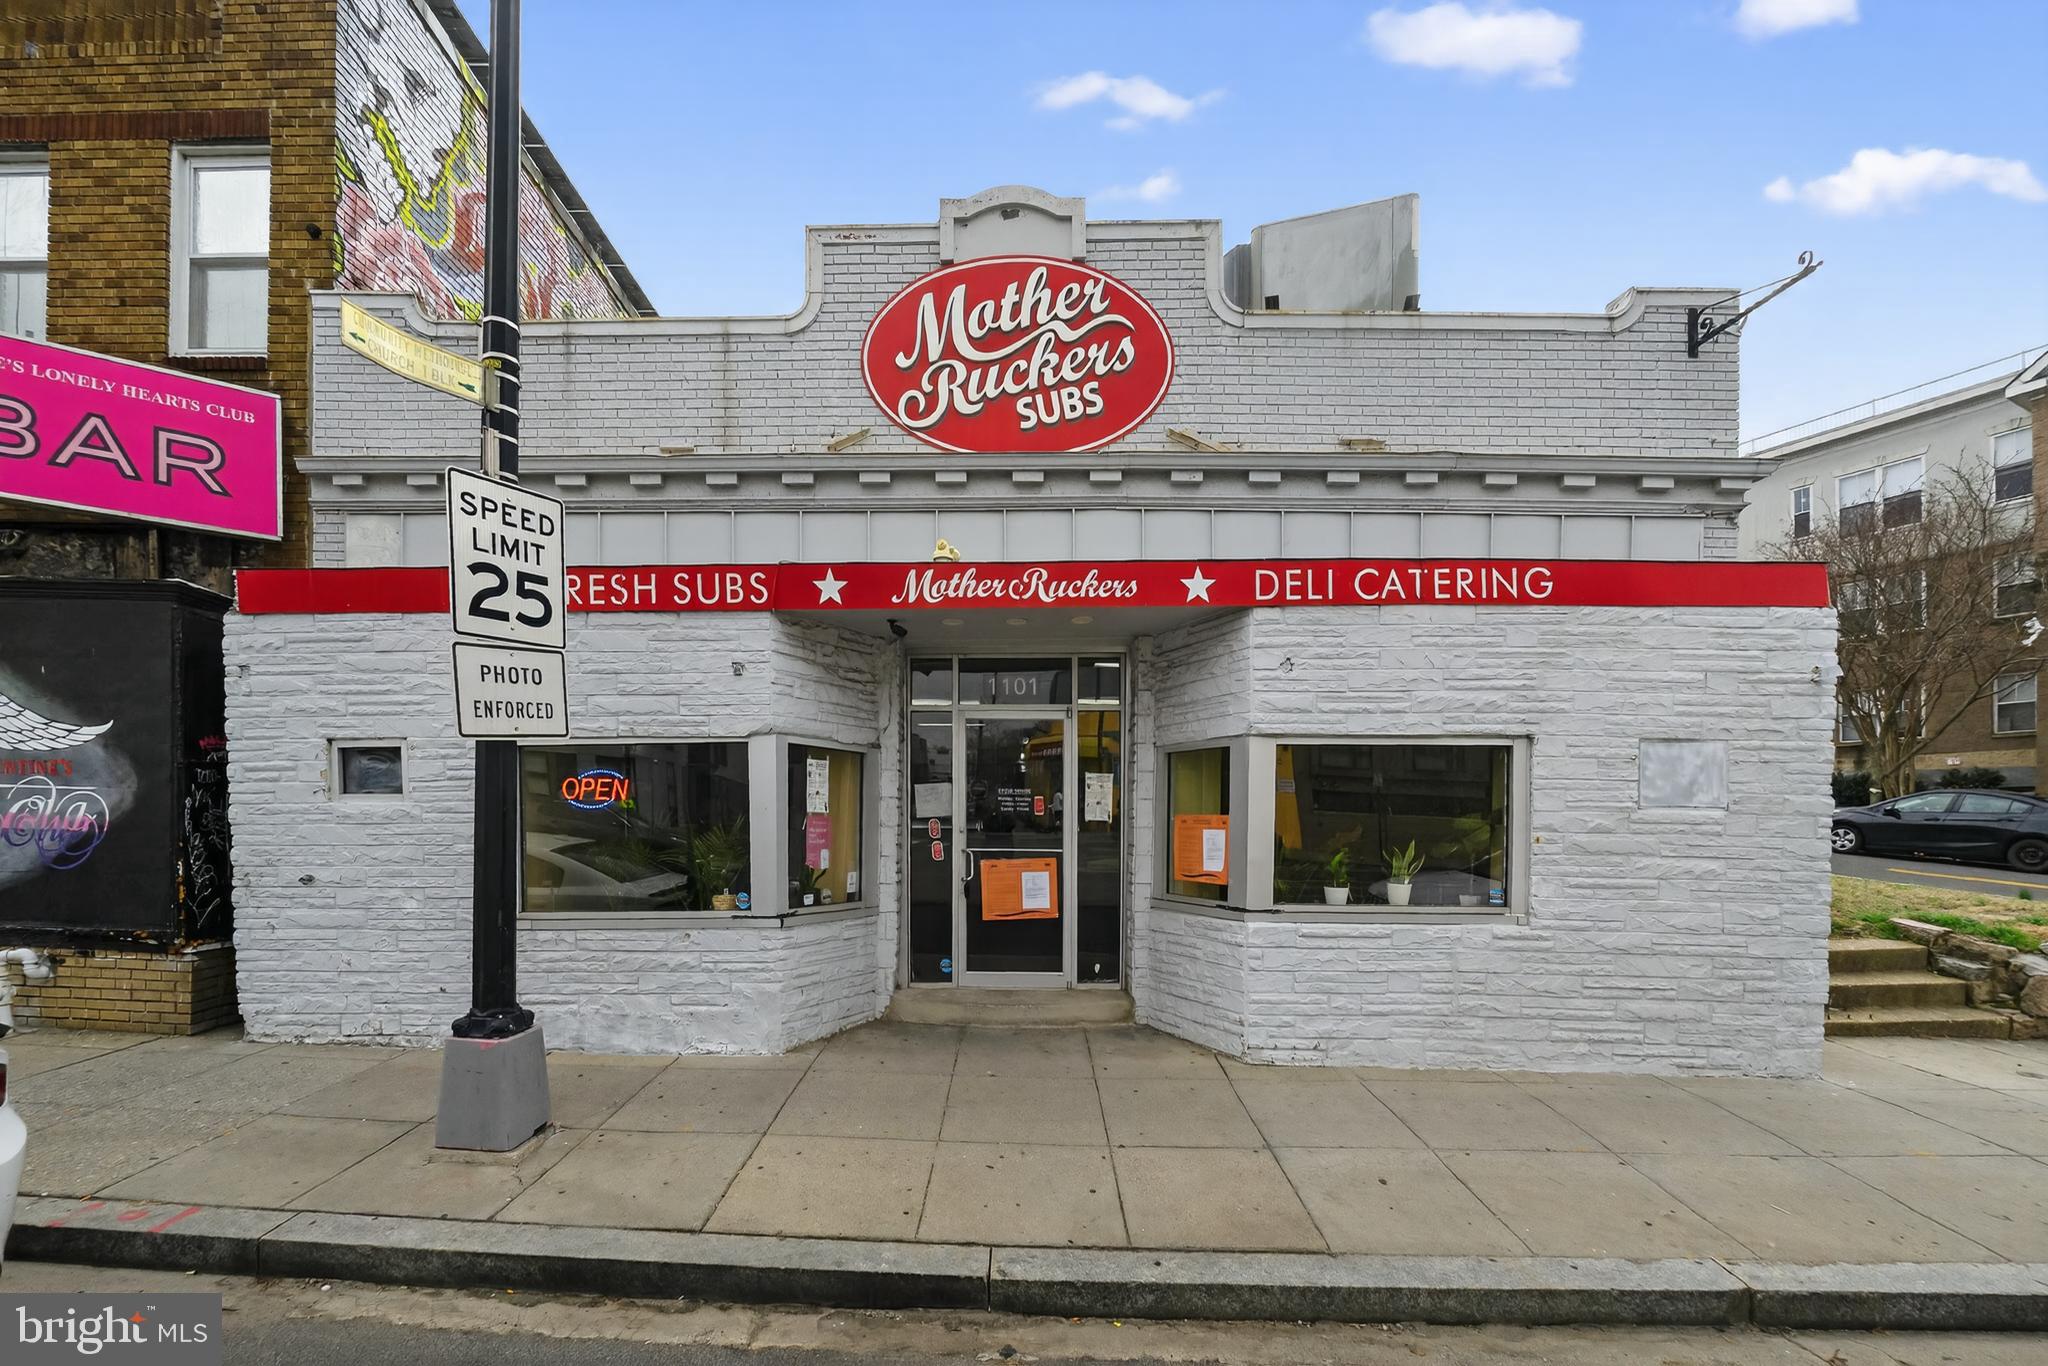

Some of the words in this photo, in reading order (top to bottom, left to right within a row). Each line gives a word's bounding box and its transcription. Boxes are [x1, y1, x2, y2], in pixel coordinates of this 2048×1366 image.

[895, 266, 1136, 368] Mother
[367, 338, 415, 374] CHURCH
[32, 364, 116, 392] LONELY
[122, 384, 200, 412] HEARTS
[206, 403, 256, 424] CLUB
[898, 331, 1136, 428] Ruckers
[1016, 382, 1103, 429] SUBS
[0, 393, 232, 498] BAR
[460, 491, 555, 537] SPEED
[472, 527, 545, 566] LIMIT
[466, 561, 552, 629] 25
[566, 573, 656, 605] RESH
[673, 571, 768, 604] SUBS
[892, 567, 1007, 604] Mother
[1008, 567, 1138, 603] Ruckers
[1255, 569, 1333, 601] DELI
[1354, 566, 1553, 600] CATERING
[480, 664, 543, 685] PHOTO
[988, 677, 1037, 696] 1101
[474, 699, 554, 720] ENFORCED
[561, 777, 630, 801] OPEN
